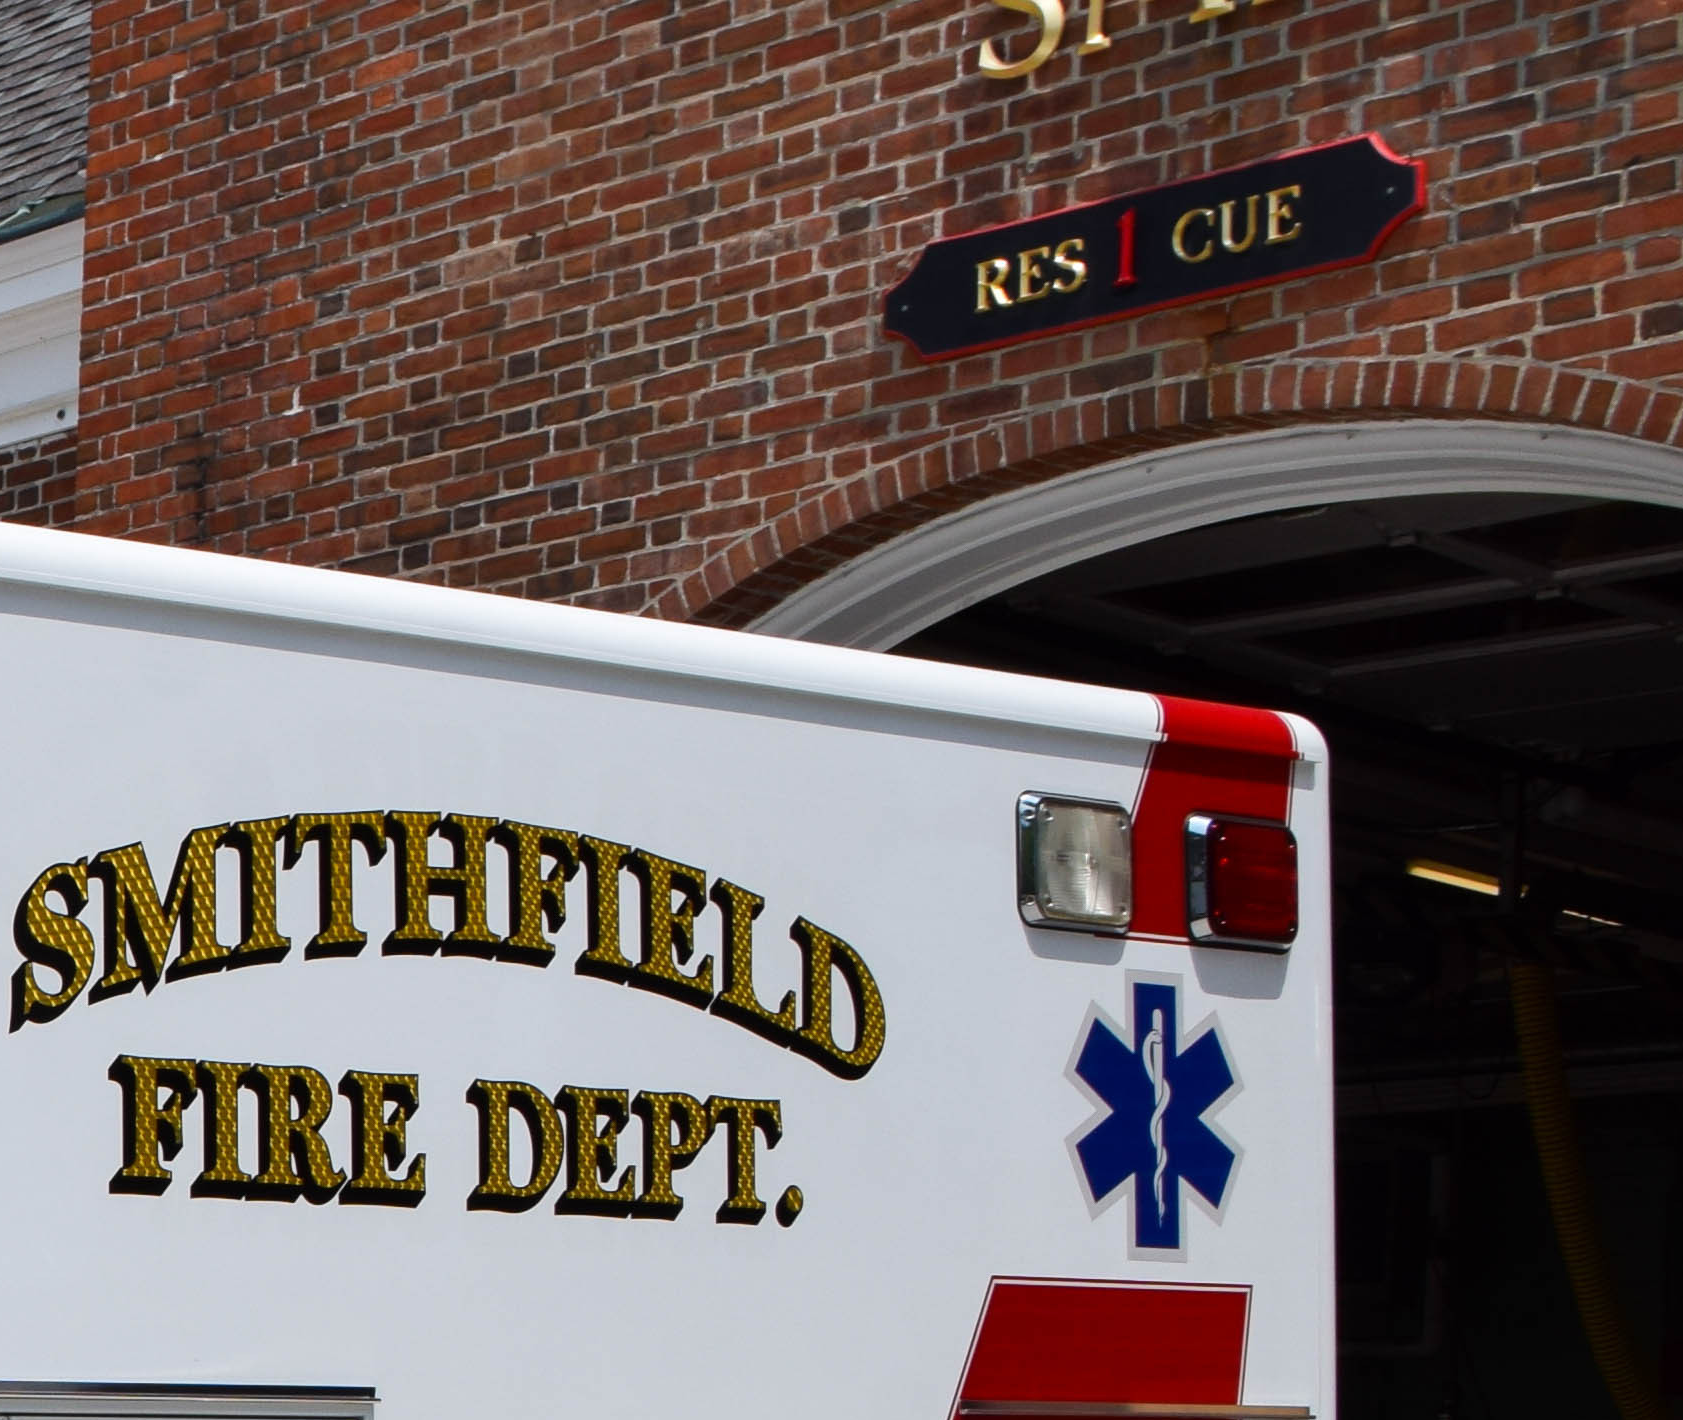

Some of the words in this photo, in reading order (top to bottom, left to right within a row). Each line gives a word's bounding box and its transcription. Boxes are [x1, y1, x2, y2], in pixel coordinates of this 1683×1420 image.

[974, 237, 1088, 315] RES
[1113, 208, 1139, 288] 1
[1171, 184, 1302, 264] CUE
[8, 809, 887, 1081] SMITHFIELD
[108, 1053, 428, 1208] FIRE
[466, 1078, 804, 1228] DEPT.
